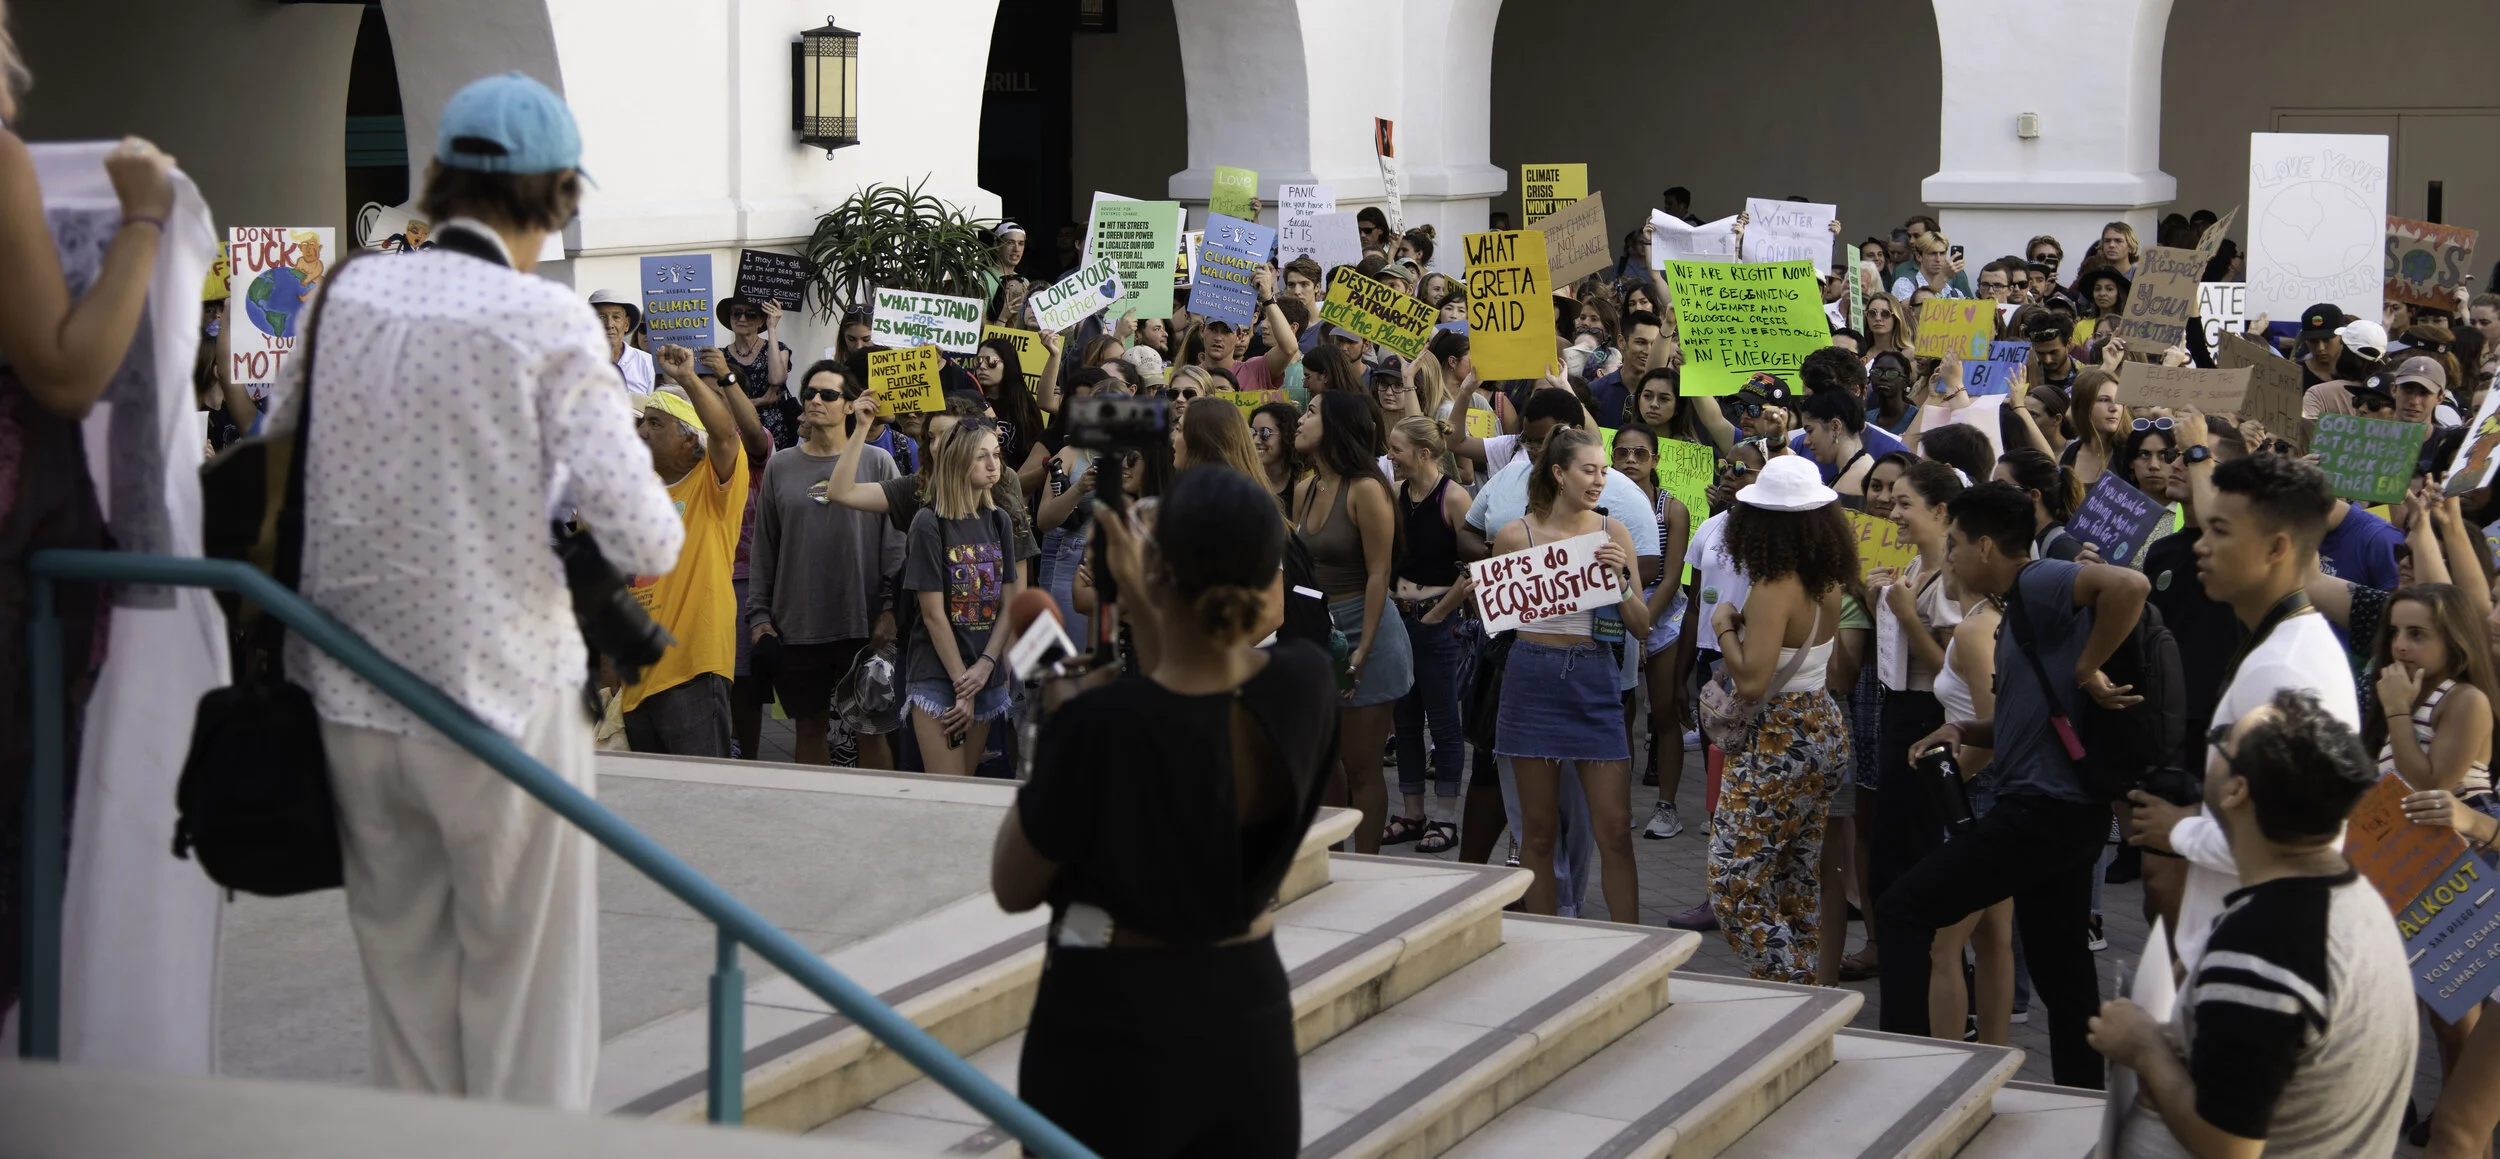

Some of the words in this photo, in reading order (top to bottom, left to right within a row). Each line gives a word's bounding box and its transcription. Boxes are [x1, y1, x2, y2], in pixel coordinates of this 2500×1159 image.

[1219, 171, 1252, 188] Love
[1526, 169, 1560, 183] CLIMATE
[2251, 155, 2315, 189] LOVE
[2320, 149, 2385, 193] YOUR
[1288, 186, 1317, 198] PANIC
[1526, 185, 1553, 198] CRISIS
[1526, 200, 1554, 214] WON'T
[1753, 203, 1813, 228] WINTER
[236, 227, 286, 243] DONT
[1557, 234, 1575, 254] NOT
[232, 241, 298, 276] FUCK
[1464, 233, 1519, 266] WHAT
[745, 252, 752, 262] I
[754, 256, 772, 268] may
[775, 257, 785, 267] be
[1120, 261, 1146, 269] POLITICAL
[1146, 261, 1165, 269] POWER
[1203, 250, 1259, 273] CLIMATE
[741, 273, 756, 281] AND
[765, 276, 795, 286] SUPPORT
[1200, 265, 1252, 286] WALKOU
[1673, 263, 1693, 279] WE
[1701, 267, 1723, 281] ARE
[1730, 266, 1778, 281] RIGHT
[740, 285, 771, 296] CLIMATE
[773, 288, 801, 299] SCIENCE
[1036, 278, 1079, 312] LOVE
[1076, 257, 1116, 291] YOUR
[1469, 267, 1536, 300] GRETA
[1689, 283, 1714, 297] THE
[2246, 264, 2381, 302] MOTHER
[1126, 292, 1140, 300] LEAP
[1197, 289, 1220, 300] YOUTH
[1222, 295, 1250, 307] DEMAND
[1337, 268, 1404, 308] DESTROY
[1406, 298, 1434, 323] THE
[2199, 286, 2246, 315] ATE
[648, 300, 708, 314] CLIMATE
[878, 293, 919, 313] WHAT
[919, 297, 933, 315] I
[933, 298, 979, 323] STAND
[1195, 298, 1221, 310] CLIMATE
[1223, 306, 1248, 316] ACTION
[1346, 291, 1430, 336] PATRIARCHY
[1680, 298, 1691, 309] OF
[1706, 300, 1756, 313] CLIMATE
[1760, 305, 1787, 314] AND
[1923, 302, 1958, 323] LOVE
[649, 317, 709, 331] WALKOUT
[1320, 300, 1353, 323] not
[1350, 310, 1373, 335] the
[1470, 301, 1525, 332] SAID
[1683, 310, 1744, 323] ECOLOGICAL
[1749, 315, 1788, 326] CRISIS
[262, 333, 294, 349] YOU
[873, 318, 891, 335] IS
[925, 327, 977, 347] STAND
[1691, 327, 1714, 336] AND
[1718, 327, 1737, 335] WE
[1741, 327, 1777, 336] NEED
[1777, 328, 1792, 337] TO
[1684, 338, 1710, 346] WHAT
[1719, 338, 1733, 346] IT
[1743, 339, 1759, 348] IS
[1917, 334, 1967, 357] MOTHER
[872, 352, 898, 366] DON'T
[901, 350, 917, 361] LET
[920, 349, 932, 359] US
[1694, 348, 1713, 363] AN
[871, 364, 902, 377] INVEST
[905, 362, 917, 373] IN
[919, 361, 927, 371] A
[1971, 365, 1992, 387] B!
[886, 373, 929, 389] FUTURE
[877, 391, 895, 402] WE
[898, 385, 931, 400] WON'T
[892, 400, 921, 413] HAVE
[2319, 414, 2361, 435] GOD
[2365, 420, 2415, 440] DIDN'T
[2336, 454, 2377, 473] FUCK
[1481, 555, 1532, 587] Let's
[1544, 545, 1568, 570] do
[1481, 562, 1616, 622] ECO-JUSTICE
[1518, 601, 1578, 624] @sdsu
[2396, 861, 2481, 942] ALKOUT
[2428, 931, 2447, 949] SAN
[2447, 908, 2475, 934] DIEGO
[2422, 948, 2464, 985] YOUTH
[2438, 959, 2487, 1000] CLIMATE
